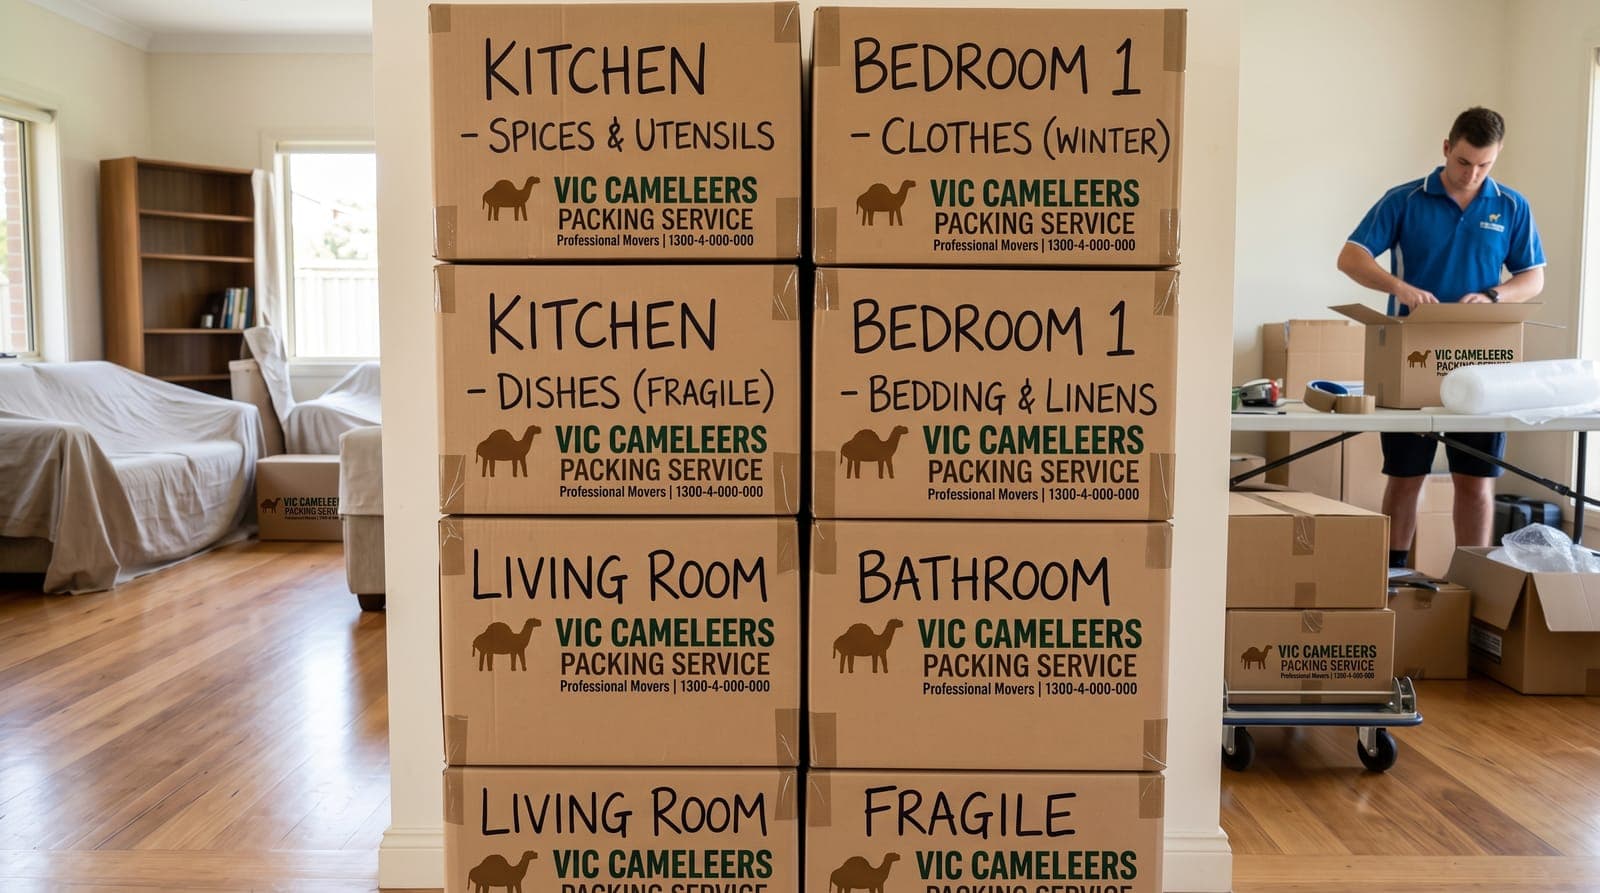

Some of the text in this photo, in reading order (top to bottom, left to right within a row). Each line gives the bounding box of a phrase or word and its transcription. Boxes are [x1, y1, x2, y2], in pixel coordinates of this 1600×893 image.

[486, 38, 706, 101] KITCHEN
[854, 37, 1141, 96] BEDROOM 1
[489, 117, 595, 153] SPICES
[608, 116, 624, 152] &
[635, 118, 775, 151] UTENSILS
[882, 117, 1032, 155] CLOTHES
[1044, 116, 1170, 163] (WINTER)
[554, 176, 758, 203] VIC CAMELEERS
[931, 179, 1140, 207] VIC CAMELEERS
[559, 208, 753, 230] PACKING SERVICE
[935, 212, 1134, 234] PACKING SERVICE
[557, 234, 619, 246] Professional
[623, 234, 659, 246] Movers
[669, 234, 753, 246] 1300-4-000-000
[934, 239, 998, 251] Professional
[1001, 239, 1038, 251] Movers
[1048, 239, 1136, 251] 1300-4-000-000
[489, 292, 716, 354] KITCHEN
[854, 298, 1135, 357] BEDROOM 1
[1435, 350, 1513, 360] VIC CAMELEERS
[497, 372, 620, 410] DISHES
[634, 368, 774, 414] (FRAGILE)
[869, 375, 1006, 415] BEDDING
[1018, 378, 1036, 414] &
[1046, 378, 1158, 416] LINENS
[555, 425, 767, 453] VIC CAMELEERS
[923, 425, 1144, 454] VIC CAMELEERS
[561, 459, 762, 481] PACKING SERVICE
[929, 460, 1139, 483] PACKING SERVICE
[284, 497, 339, 507] VIC CAMELEE
[560, 486, 625, 498] Professional
[628, 486, 666, 498] Movers
[676, 486, 763, 498] 1300-4-000-000
[928, 488, 996, 500] Professional
[998, 488, 1038, 500] Movers
[1049, 488, 1139, 500] 1300-4-000-000
[285, 507, 316, 515] PACKING
[472, 549, 768, 604] LIVING ROOM
[858, 549, 1110, 606] BATHROOM
[555, 618, 774, 647] VIC CAMELEERS
[918, 618, 1142, 648] VIC CAMELEERS
[561, 652, 769, 675] PACKING SERVICE
[923, 654, 1137, 677] PACKING SERVICE
[1278, 645, 1377, 658] VIC CAMELEERS
[1281, 660, 1374, 671] PACKING SERVICE
[560, 680, 627, 692] Professional
[631, 680, 669, 692] Movers
[681, 680, 770, 692] 1300-4-000-000
[923, 682, 991, 695] Professional
[995, 682, 1034, 695] Movers
[1046, 682, 1138, 695] 1300-4-000-000
[482, 786, 767, 838] LIVING ROOM
[864, 785, 1077, 839] FRAGILE
[553, 849, 772, 878] VIC CAMELEERS
[916, 851, 1137, 880] VIC CAMELEERS
